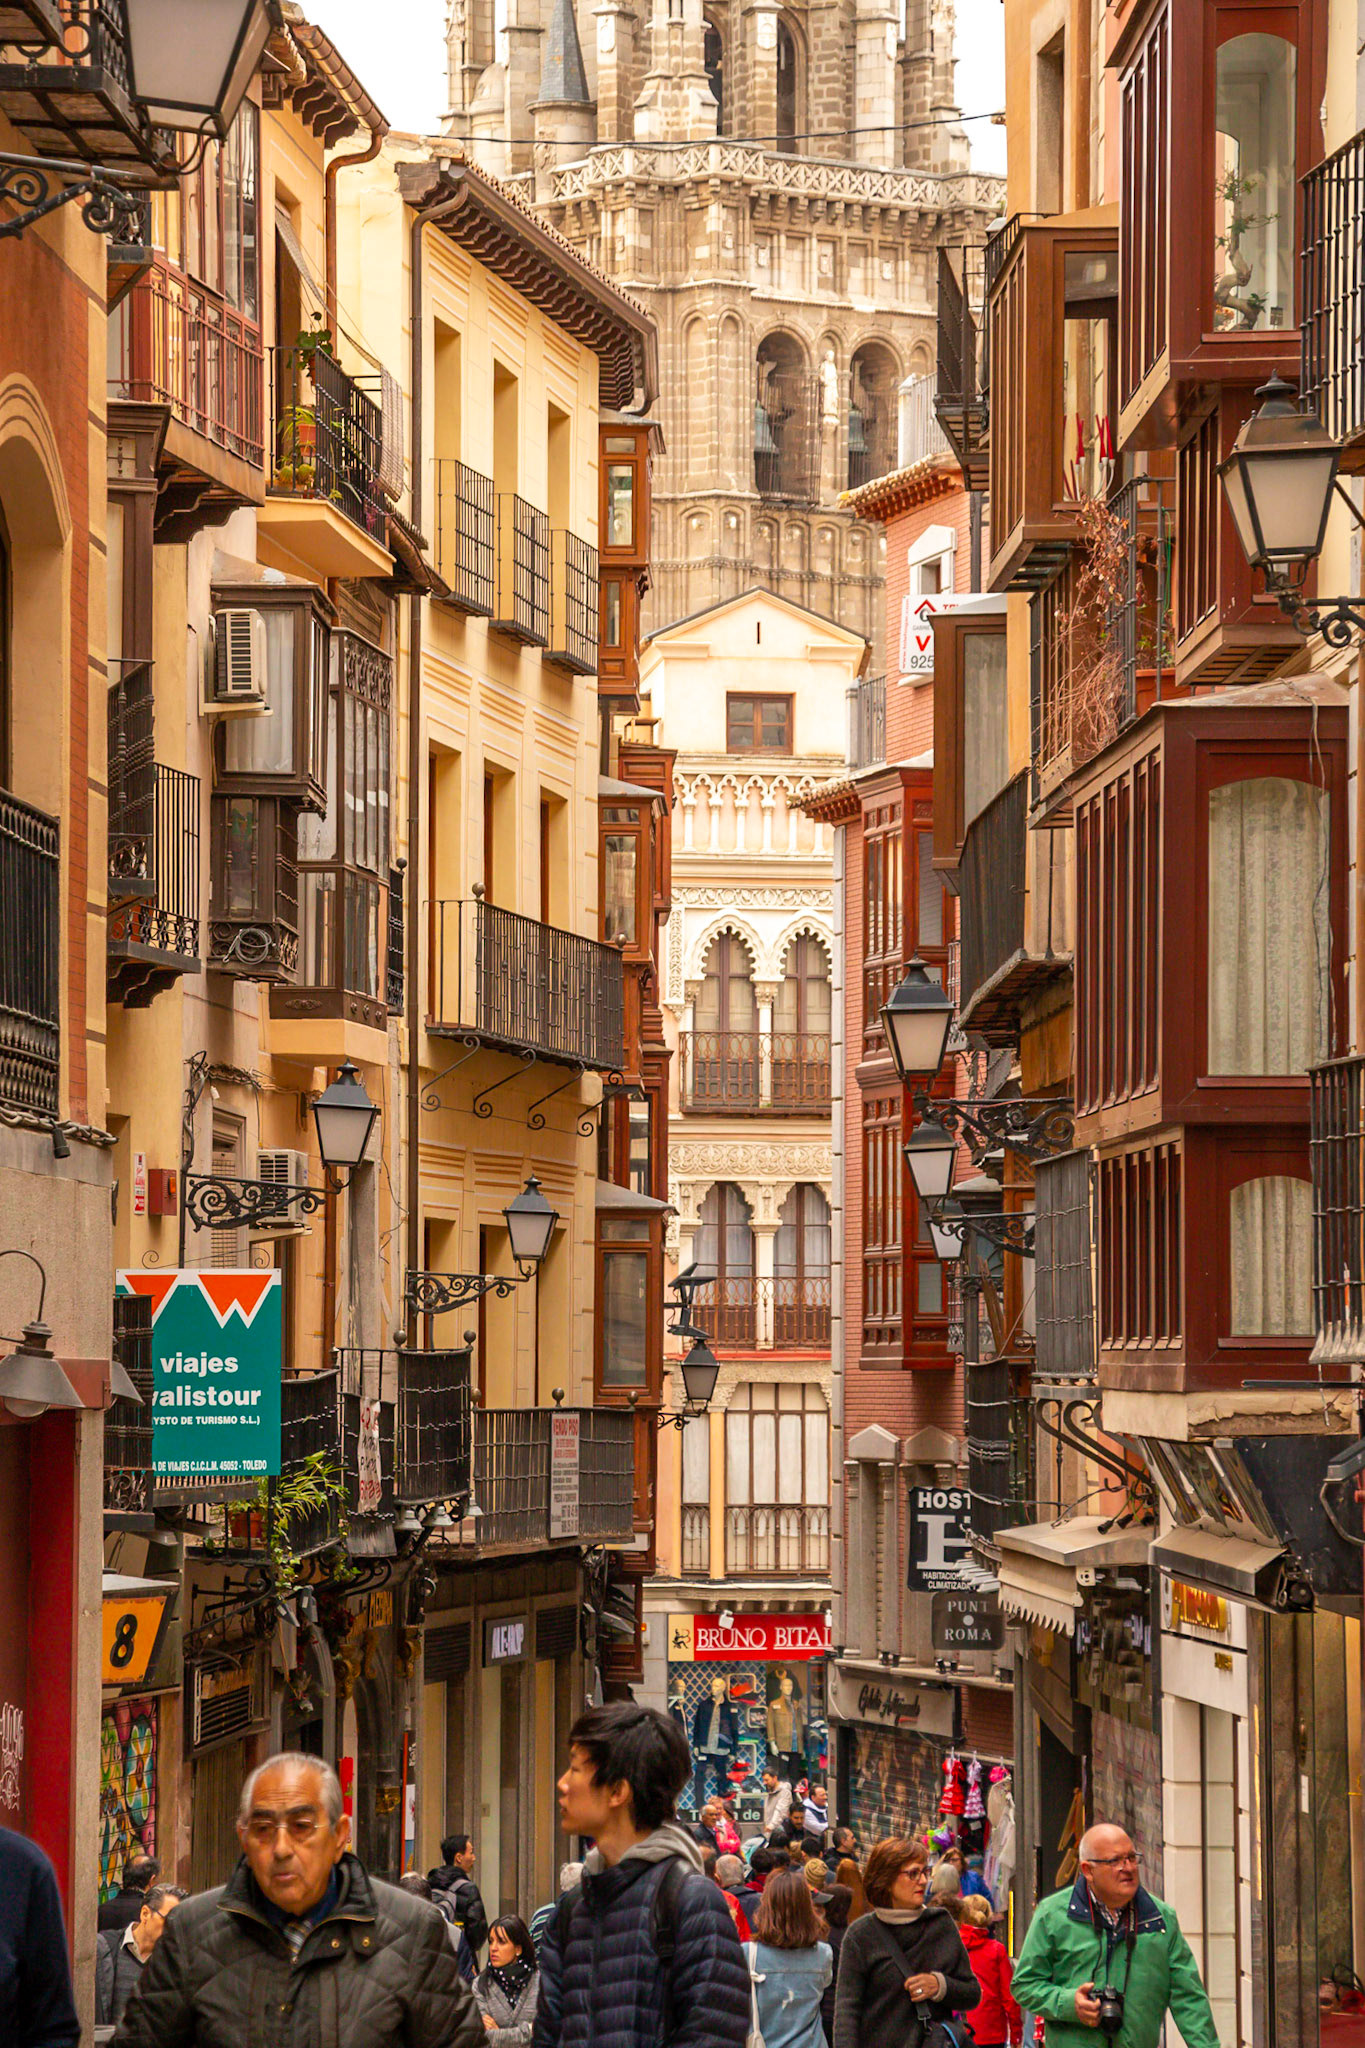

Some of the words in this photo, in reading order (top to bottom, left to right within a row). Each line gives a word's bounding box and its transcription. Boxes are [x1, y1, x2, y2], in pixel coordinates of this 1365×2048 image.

[160, 1351, 239, 1378] viajes
[180, 1415, 193, 1425] DE
[196, 1415, 238, 1425] TURISMO
[239, 1415, 260, 1426] S.L.)
[159, 1461, 167, 1472] DE
[168, 1461, 190, 1472] VIAJES
[242, 1459, 268, 1471] TOLEDO
[109, 1613, 138, 1668] 8
[696, 1627, 767, 1649] BRUNO
[944, 1627, 993, 1641] ROMA
[742, 1808, 761, 1821] de
